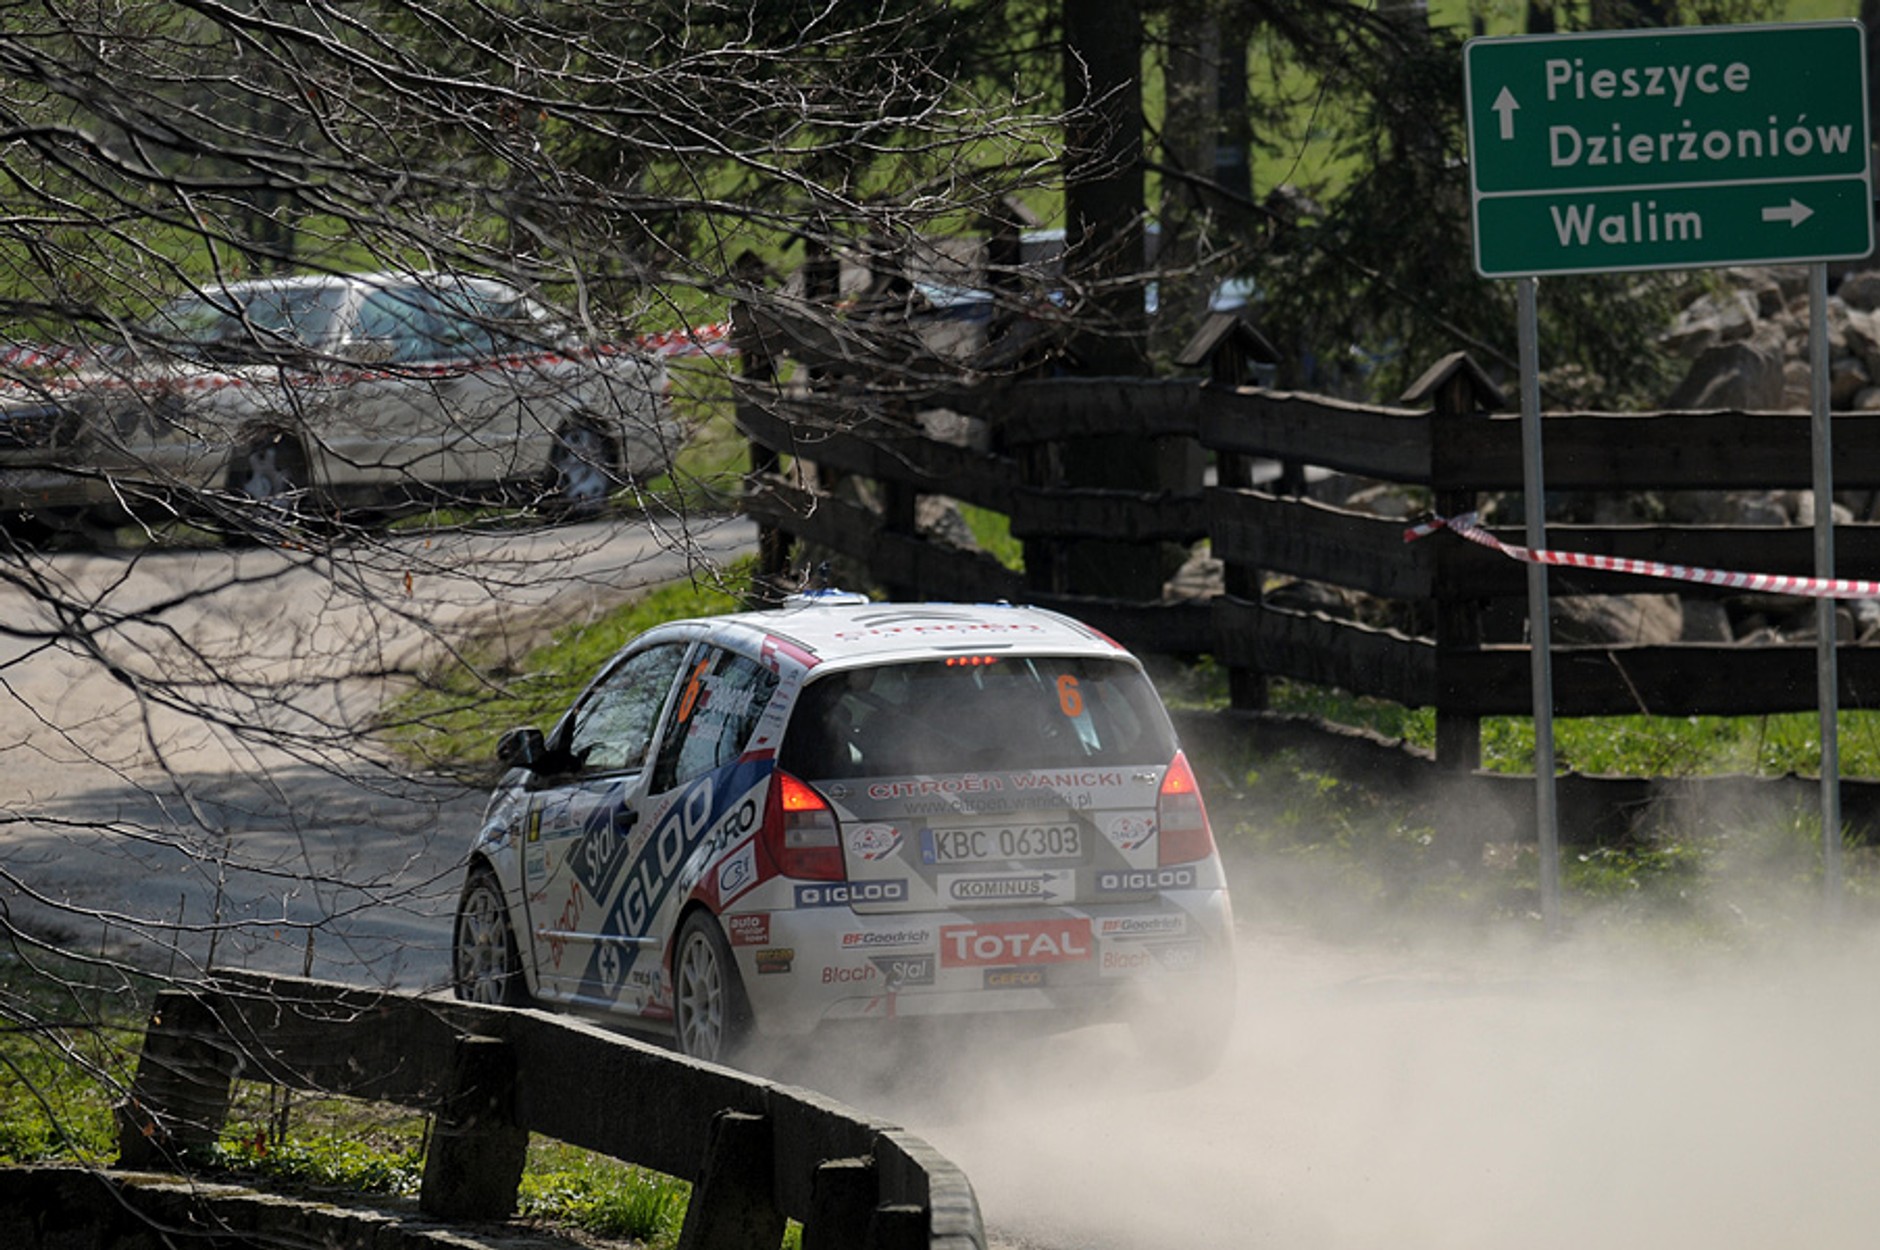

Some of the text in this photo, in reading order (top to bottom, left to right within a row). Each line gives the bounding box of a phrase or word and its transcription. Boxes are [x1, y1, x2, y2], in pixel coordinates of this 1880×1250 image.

[1545, 58, 1750, 107] Pieszyce
[1549, 114, 1853, 167] Dzierżoniów
[1550, 200, 1702, 247] Walim
[678, 659, 709, 723] 6
[1056, 675, 1084, 717] 6
[1014, 772, 1122, 789] WANICKI
[935, 833, 988, 862] KBC
[1000, 827, 1079, 856] 06303
[616, 777, 713, 952] IGLOO
[959, 880, 1040, 896] KOMINUS
[1122, 870, 1190, 888] IGLOO
[824, 884, 900, 902] IGLOO
[1102, 917, 1182, 931] BFGoodrich
[842, 930, 930, 945] BFGoodrich
[1103, 951, 1151, 969] Blach
[821, 963, 876, 983] Blach
